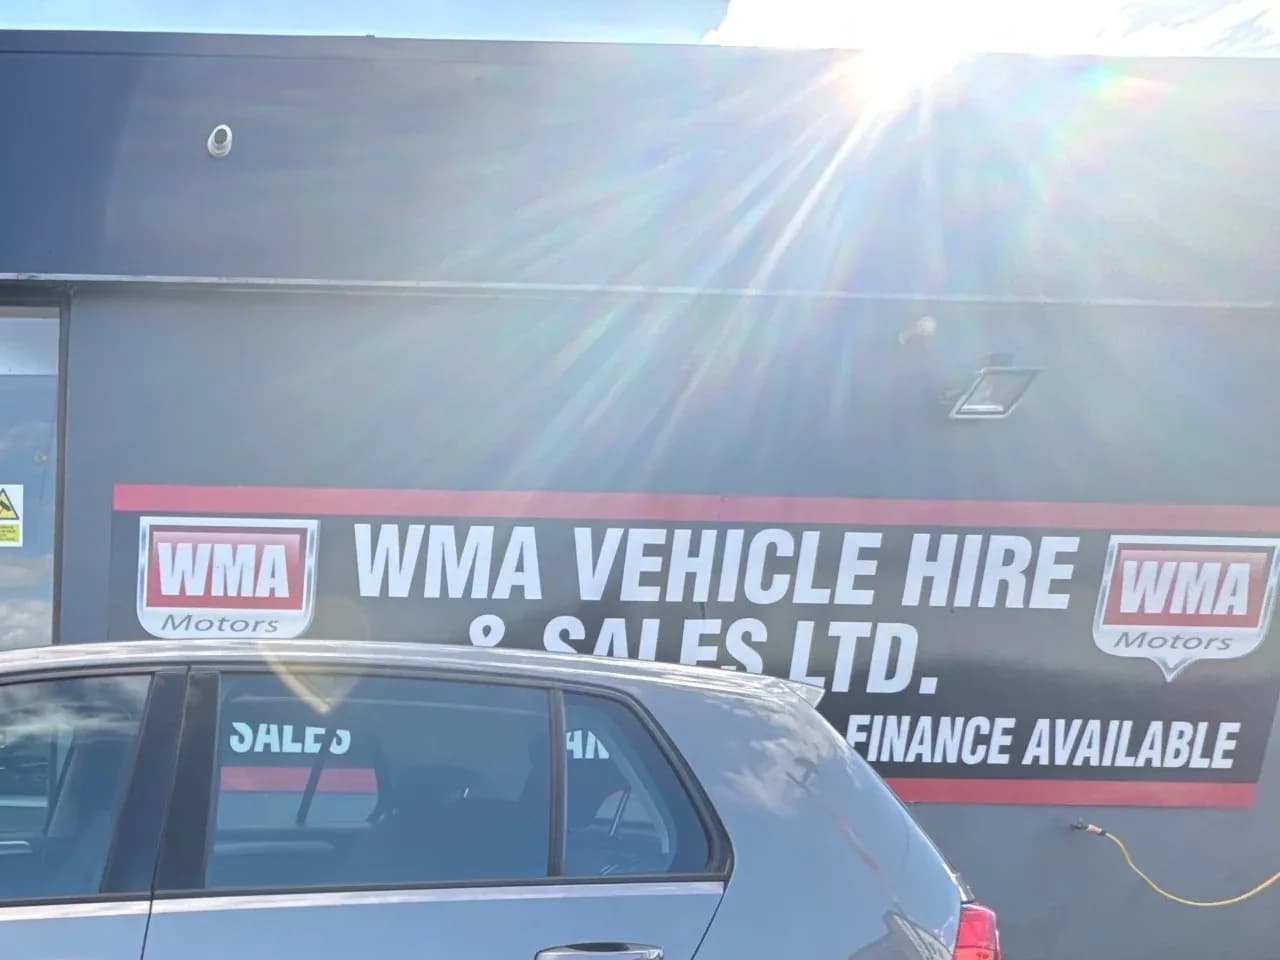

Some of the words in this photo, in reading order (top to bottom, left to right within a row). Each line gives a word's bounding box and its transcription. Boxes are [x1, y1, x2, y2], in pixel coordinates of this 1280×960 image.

[156, 541, 290, 599] WMA
[353, 523, 543, 600] WMA
[574, 527, 883, 606] VEHICLE
[901, 532, 1081, 610] HIRE
[1119, 560, 1251, 616] WMA
[161, 613, 280, 634] Motors
[1113, 631, 1235, 652] Motors
[788, 620, 939, 695] LTD.
[846, 714, 1017, 765] FINANCE
[1021, 719, 1241, 769] AVAILABLE
